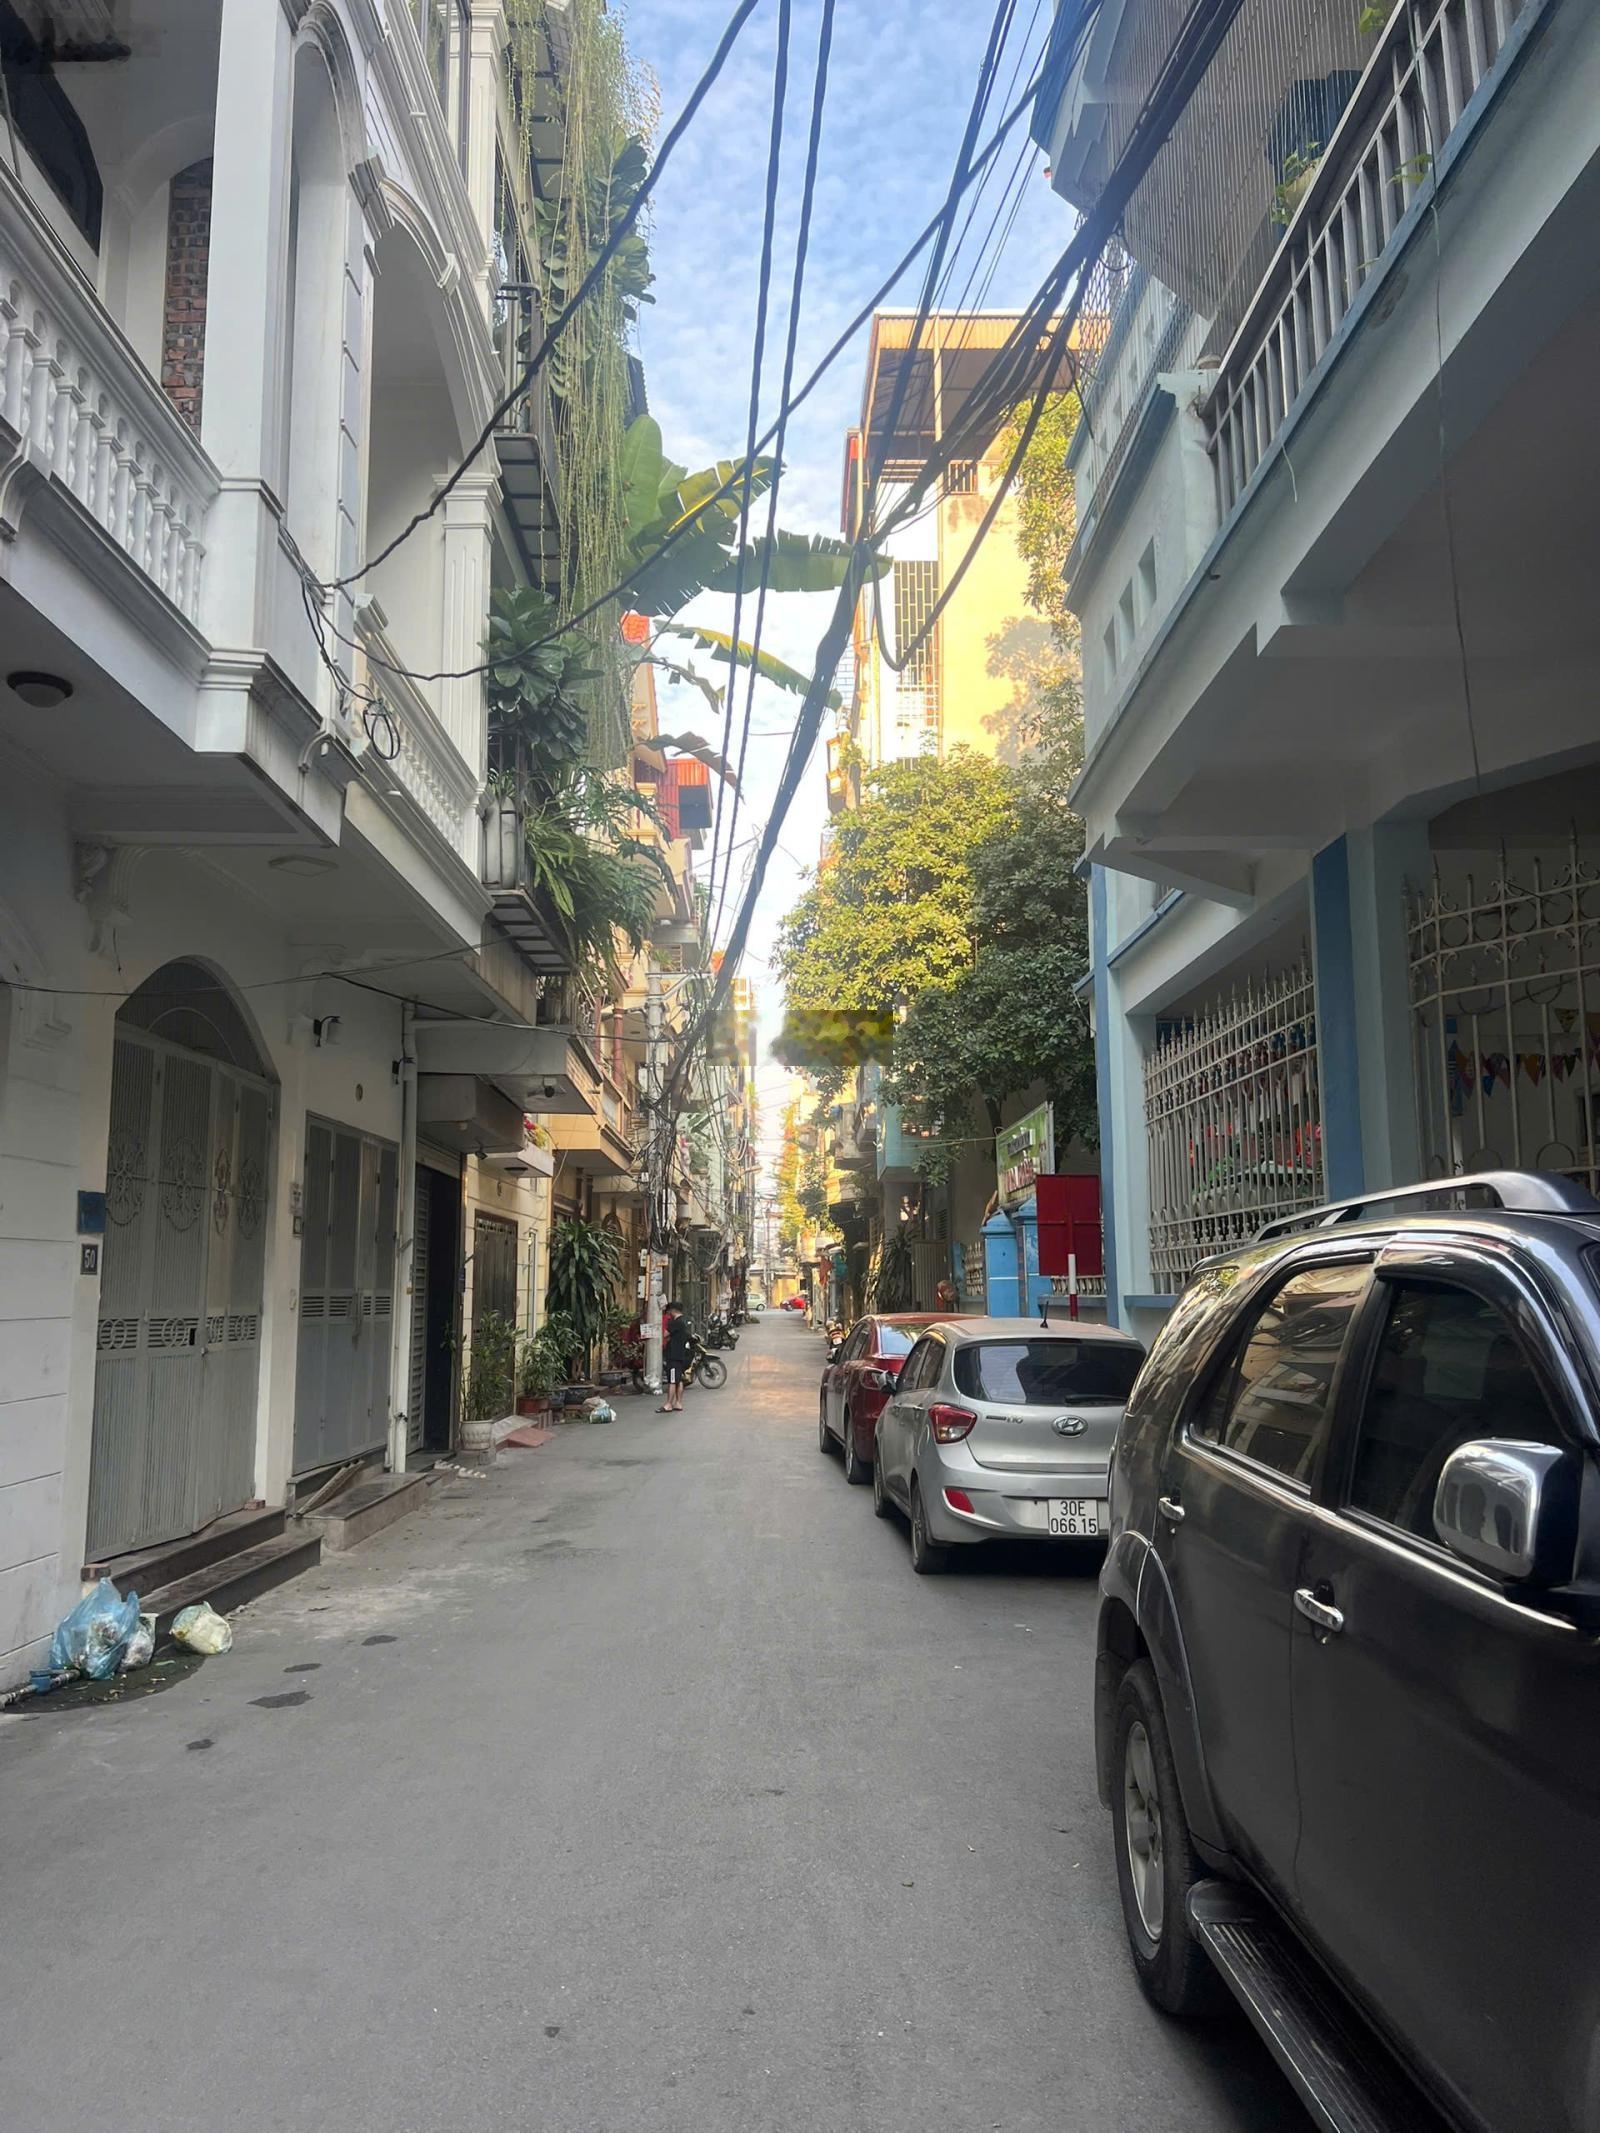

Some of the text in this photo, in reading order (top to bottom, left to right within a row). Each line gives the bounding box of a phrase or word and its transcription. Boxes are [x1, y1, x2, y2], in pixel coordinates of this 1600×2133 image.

[84, 1248, 96, 1269] 50
[1060, 1500, 1087, 1516] 30E
[1050, 1517, 1097, 1534] 066.15
